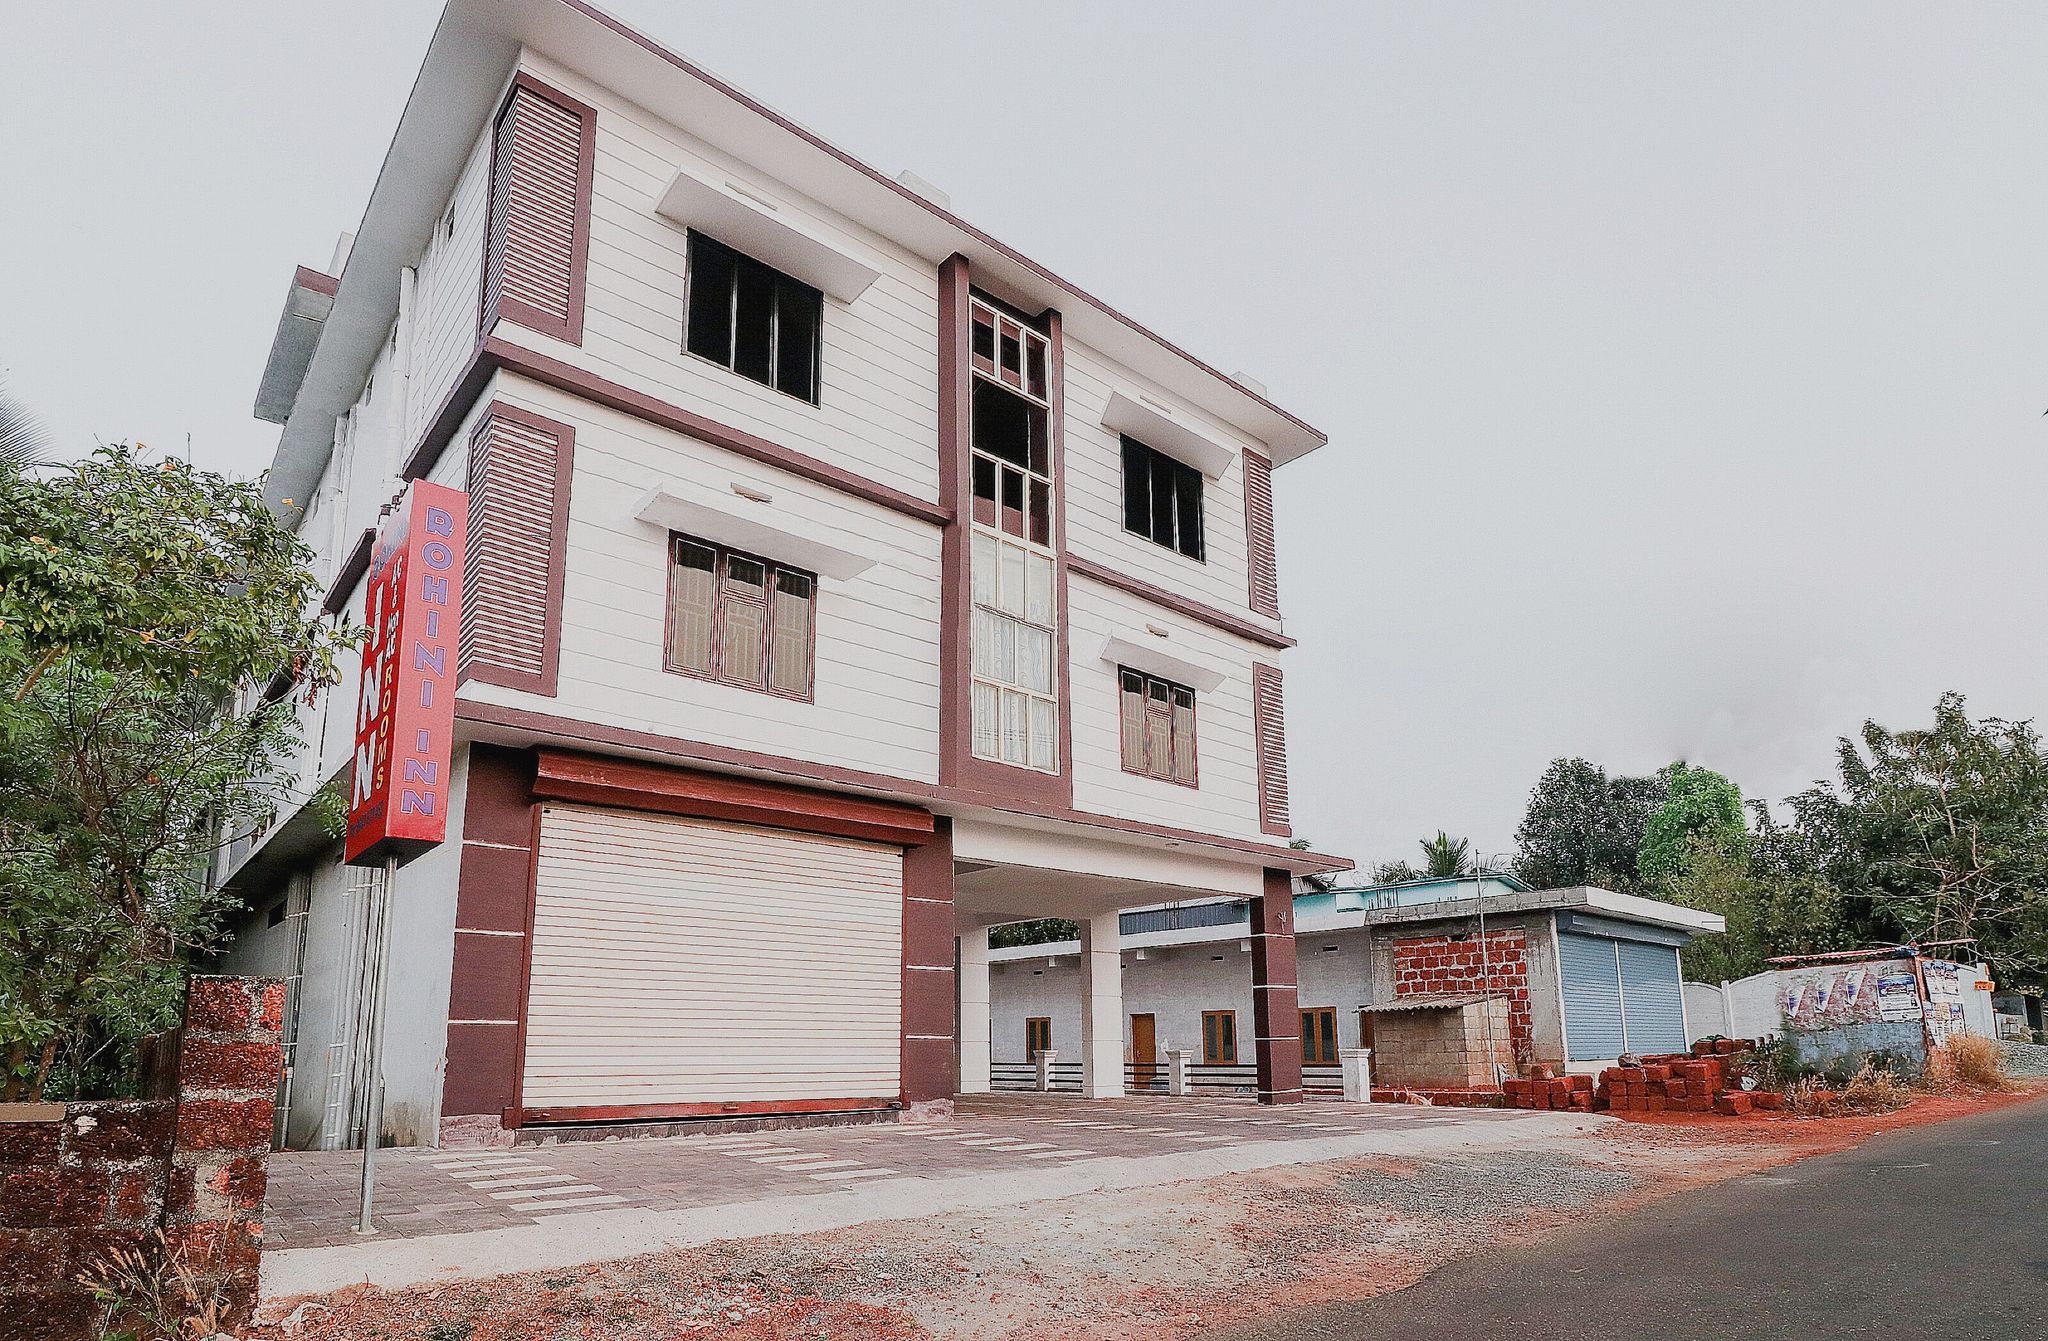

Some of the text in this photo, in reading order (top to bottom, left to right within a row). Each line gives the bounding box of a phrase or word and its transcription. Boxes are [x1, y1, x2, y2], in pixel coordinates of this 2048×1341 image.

[352, 581, 385, 812] INN
[376, 663, 393, 790] ROOMS
[401, 506, 454, 816] ROHINI INN
